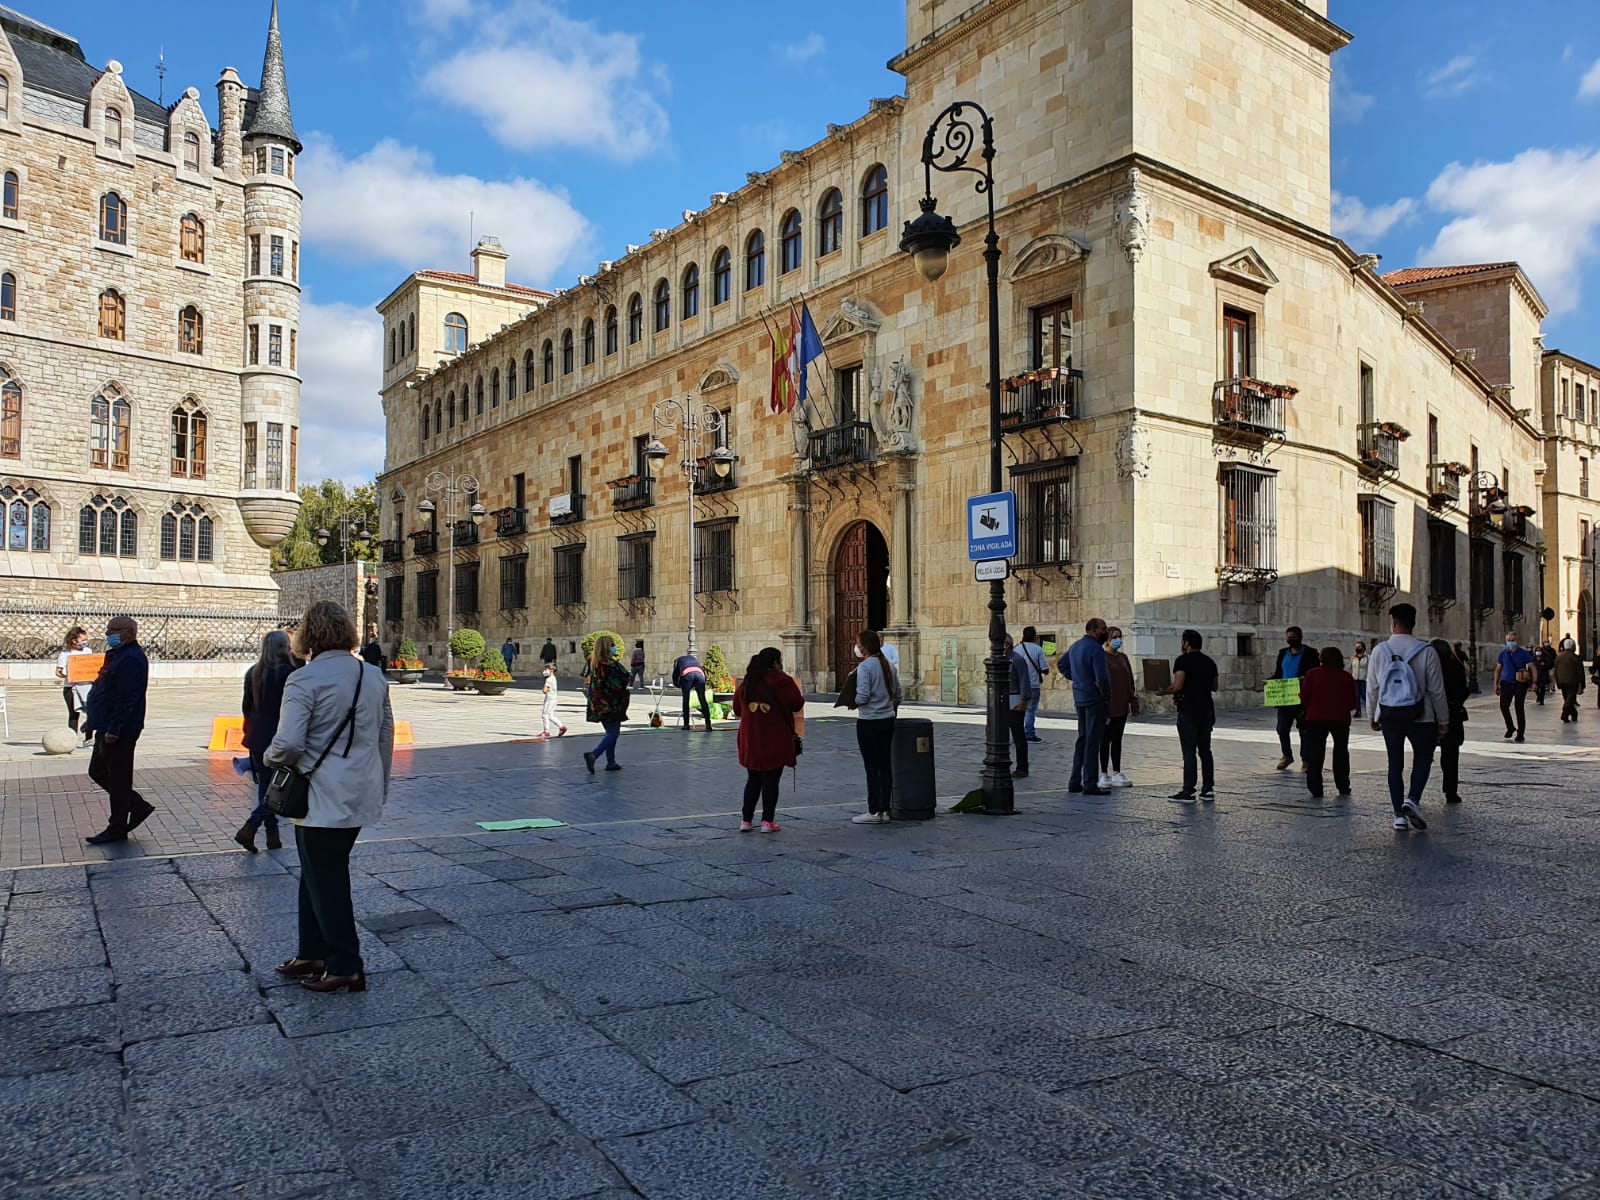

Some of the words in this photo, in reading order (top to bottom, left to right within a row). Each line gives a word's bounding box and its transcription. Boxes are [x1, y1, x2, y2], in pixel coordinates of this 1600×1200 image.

[970, 544, 985, 552] ZONA
[986, 541, 1012, 550] VIGILADA
[993, 566, 1005, 574] LOCAL
